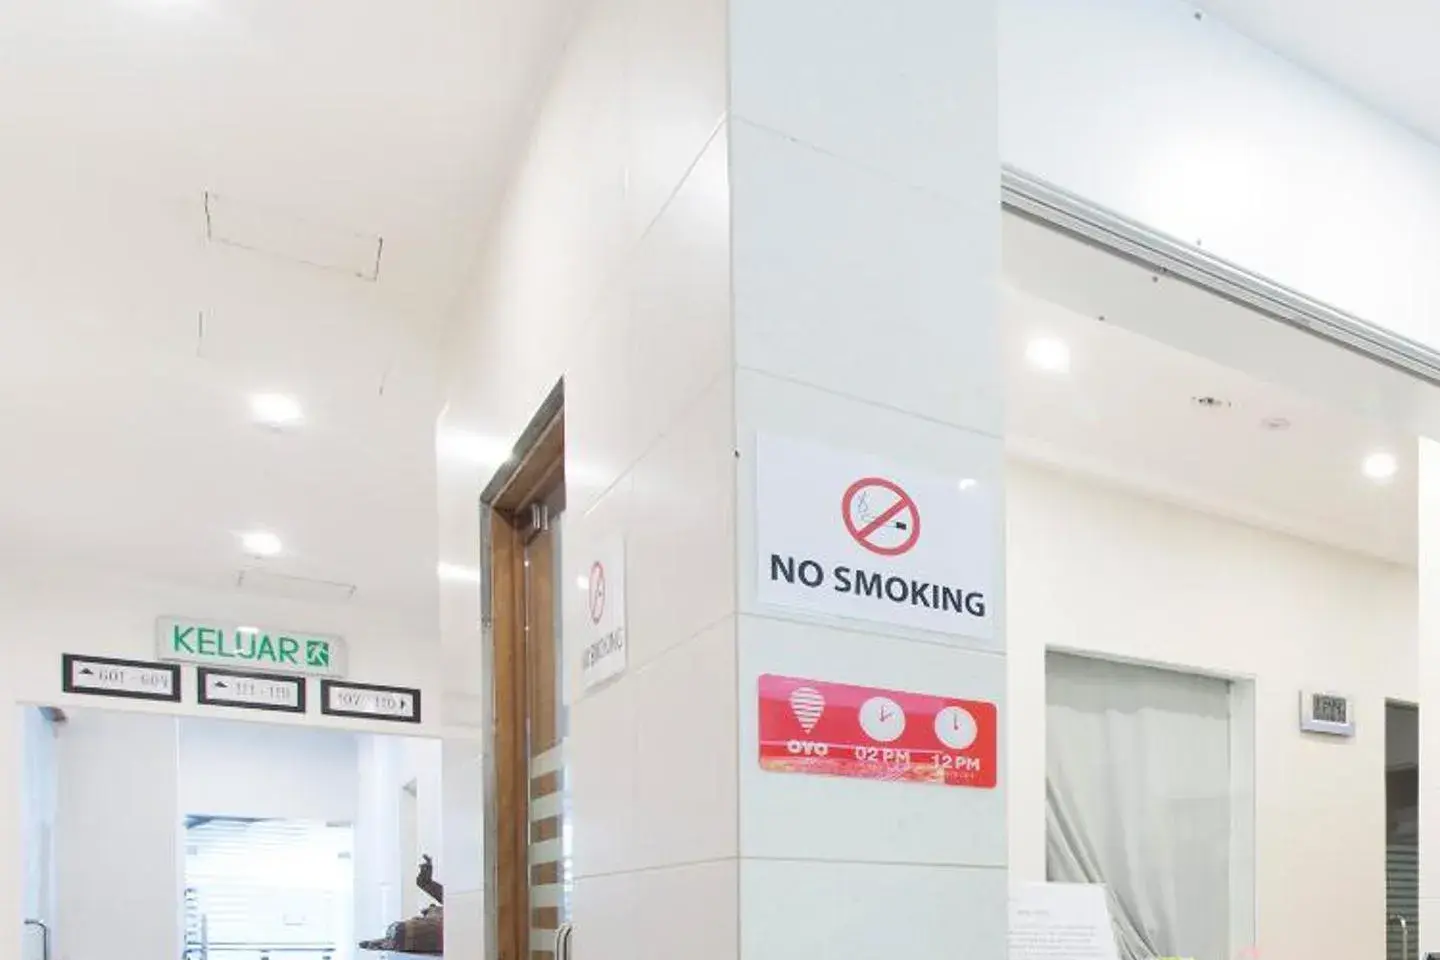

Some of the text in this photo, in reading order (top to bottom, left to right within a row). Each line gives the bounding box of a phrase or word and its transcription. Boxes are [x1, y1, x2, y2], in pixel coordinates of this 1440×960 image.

[770, 553, 986, 617] NO SMOKING
[173, 624, 300, 666] KELUAR
[786, 739, 829, 756] OYO
[855, 746, 911, 767] 02 PM
[932, 754, 981, 771] 12 PM
